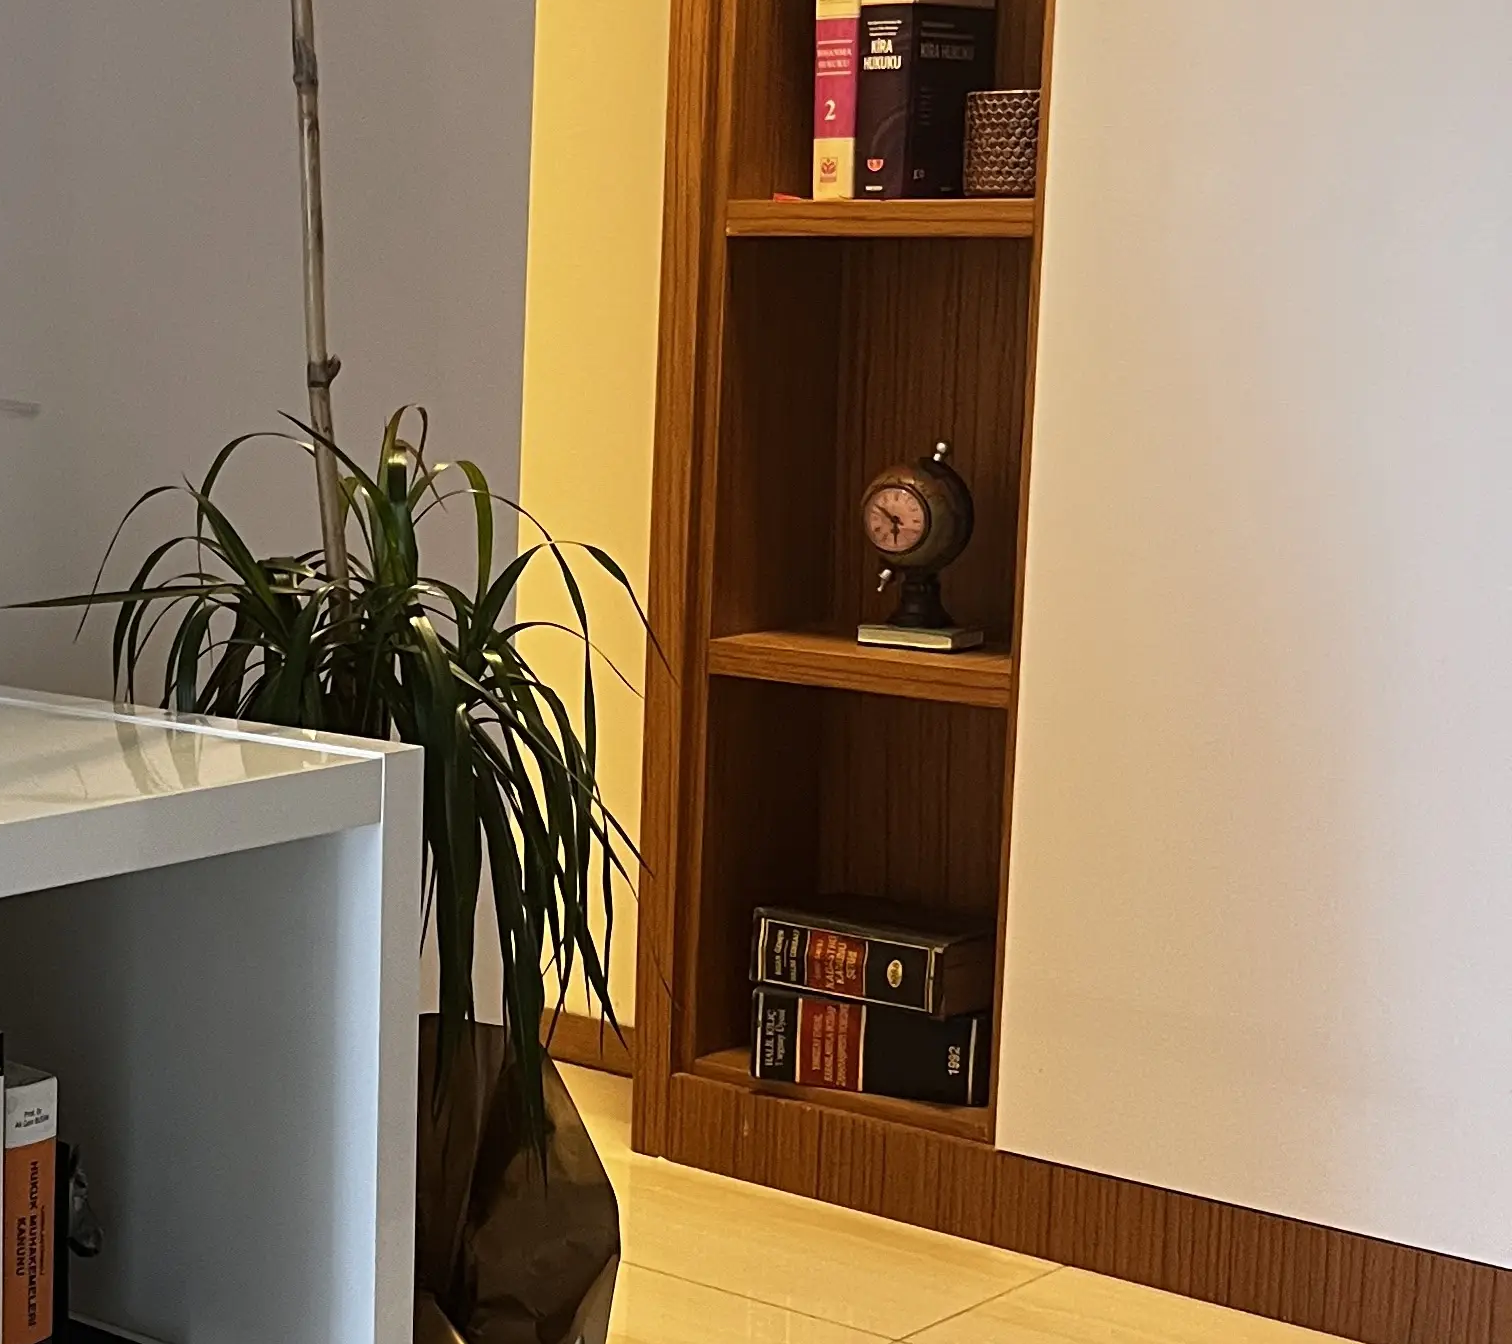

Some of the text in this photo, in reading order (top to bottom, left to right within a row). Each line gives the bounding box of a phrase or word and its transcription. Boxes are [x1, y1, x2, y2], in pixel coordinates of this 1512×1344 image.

[871, 38, 893, 54] KİRA
[863, 55, 902, 70] HUKUKU
[824, 100, 836, 120] 2
[947, 1044, 961, 1076] 1992
[16, 1216, 27, 1277] KANUNU
